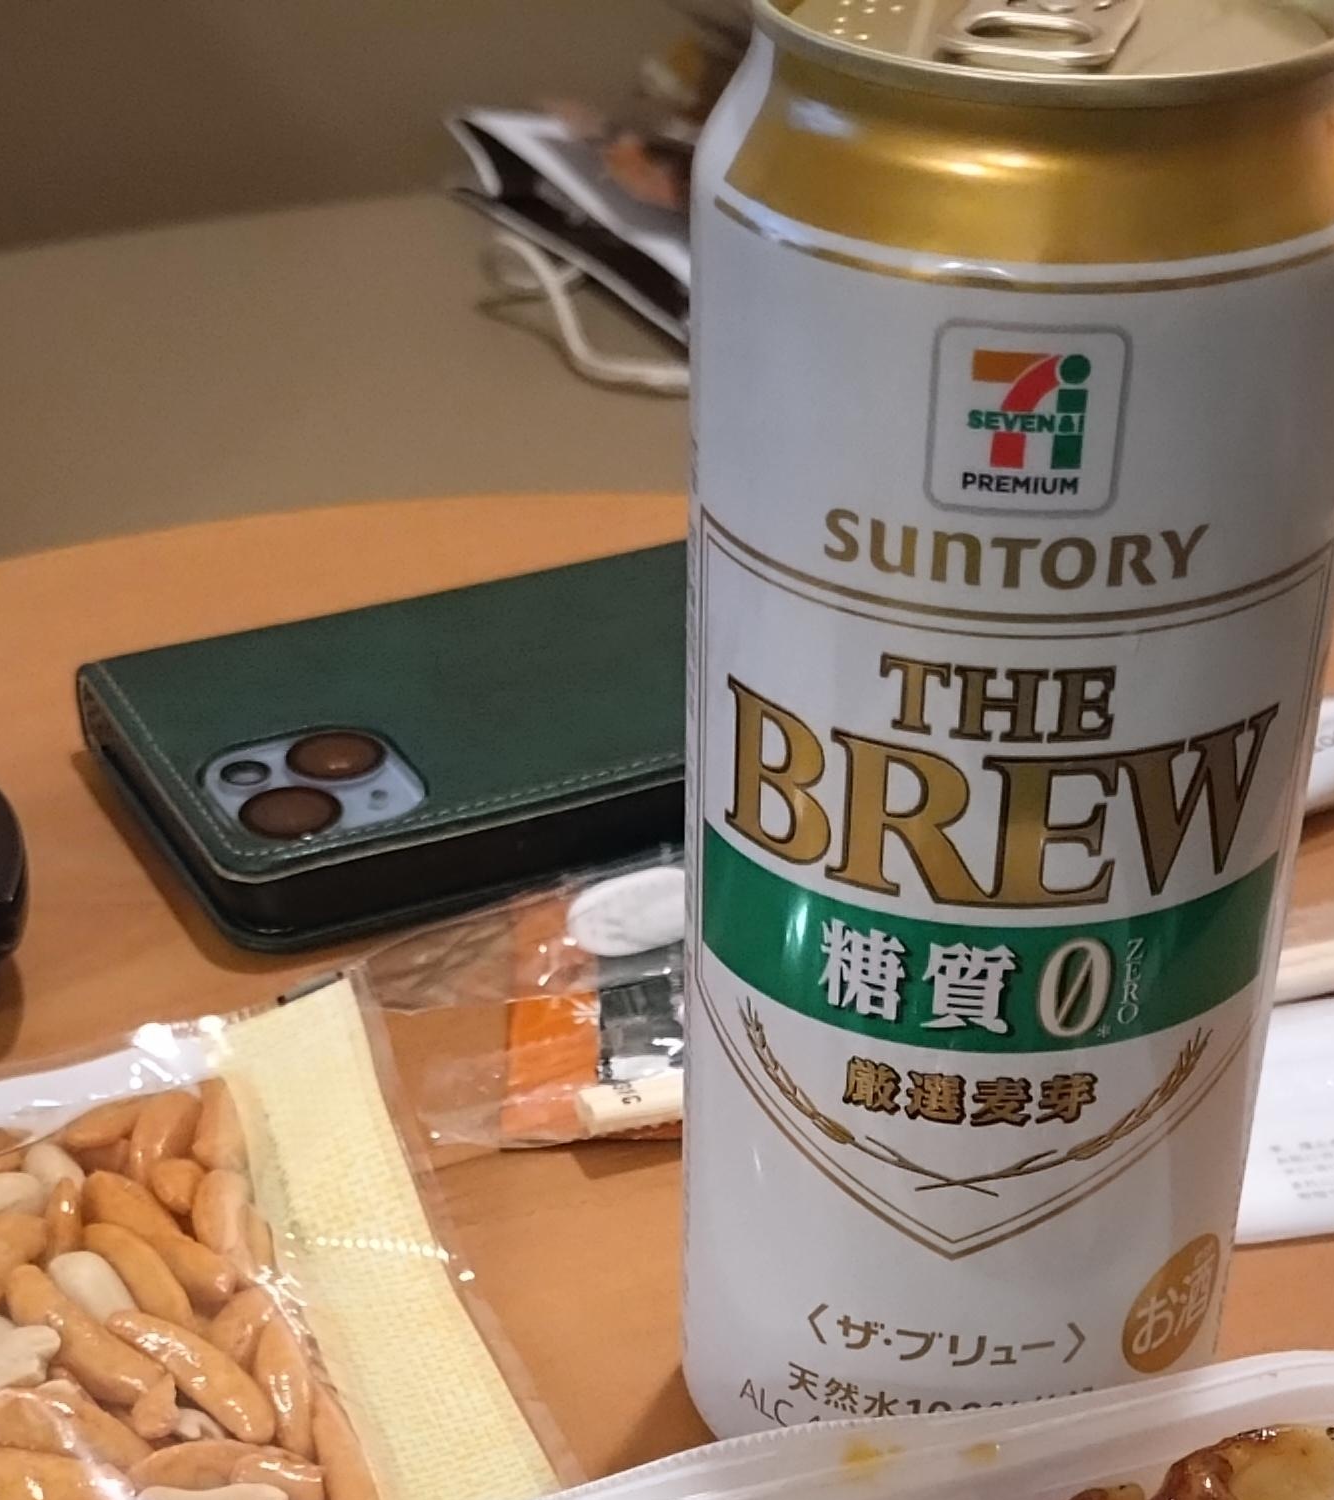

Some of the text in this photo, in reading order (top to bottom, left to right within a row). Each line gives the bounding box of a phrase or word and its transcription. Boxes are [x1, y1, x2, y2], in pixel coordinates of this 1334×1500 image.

[961, 472, 1079, 496] PREMIUM
[879, 652, 1118, 743] THE
[724, 673, 1280, 910] BREW
[1117, 937, 1147, 1026] ZERO
[843, 1056, 1100, 1128] 厳選麦芽
[1134, 1255, 1216, 1355] お酒
